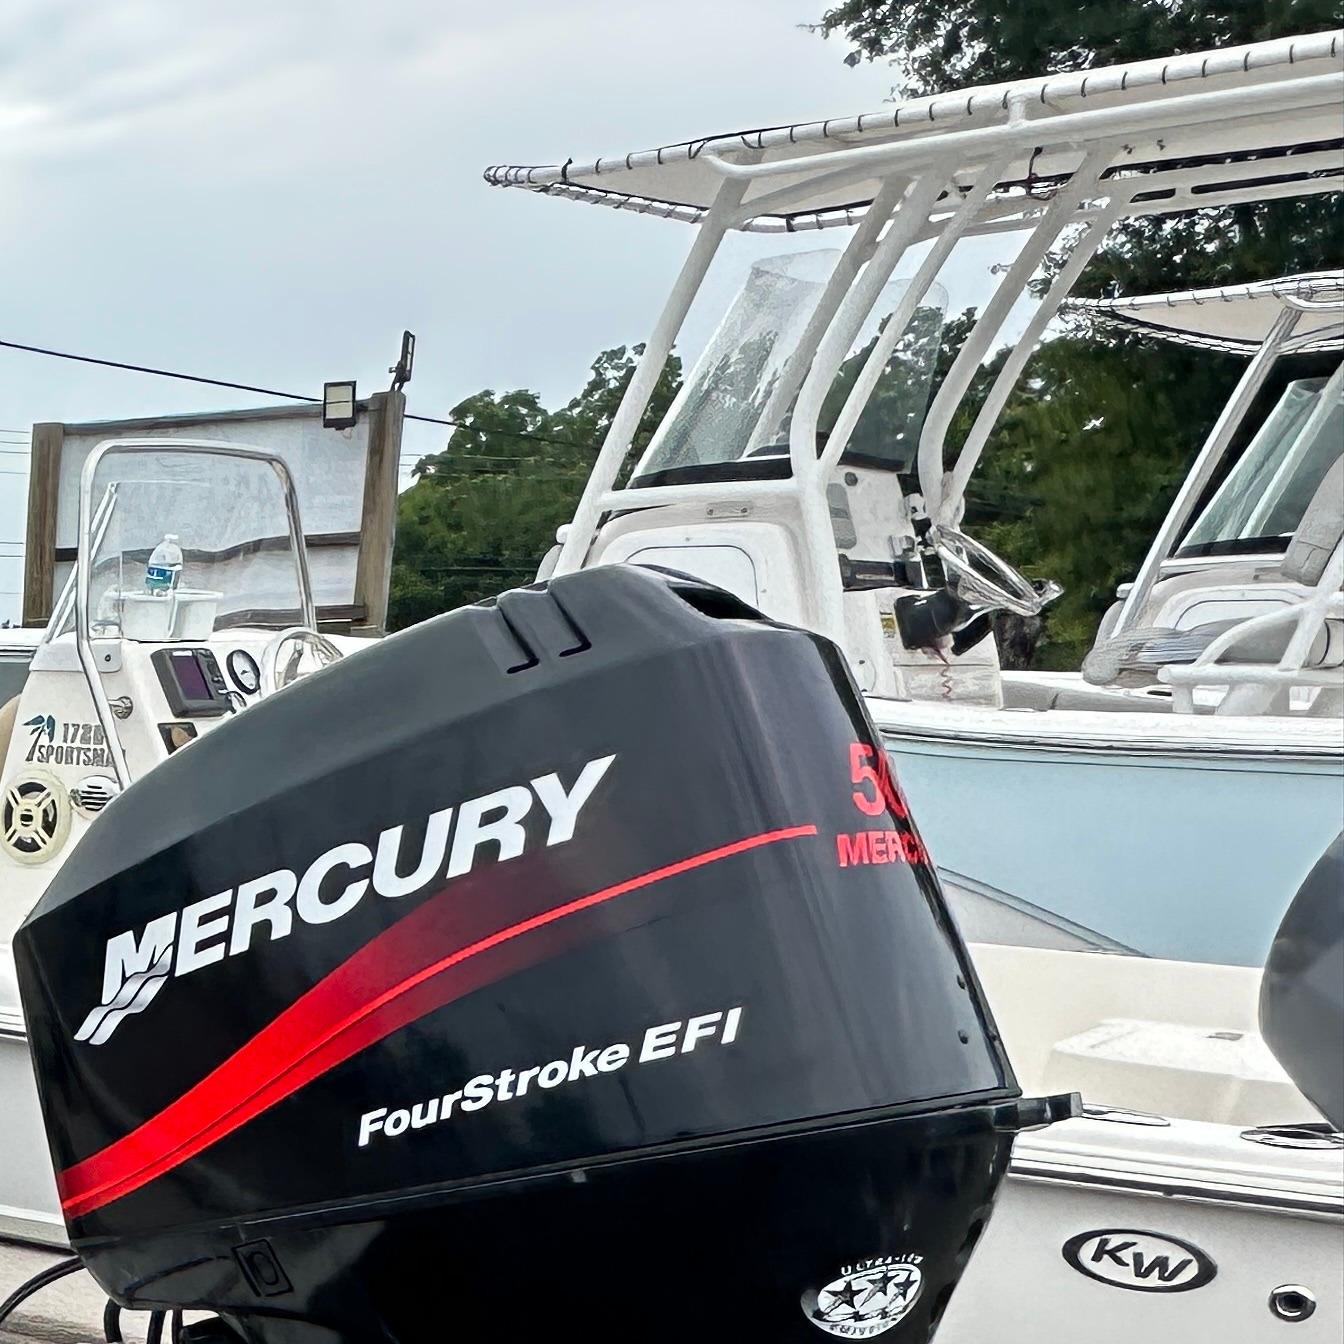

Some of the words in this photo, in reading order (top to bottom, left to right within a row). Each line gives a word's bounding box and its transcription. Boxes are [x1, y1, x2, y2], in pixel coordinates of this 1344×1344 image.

[100, 753, 617, 1008] MERCURY
[358, 1042, 630, 1147] FourStroke
[638, 1006, 743, 1063] EFI
[1091, 1238, 1194, 1282] KW
